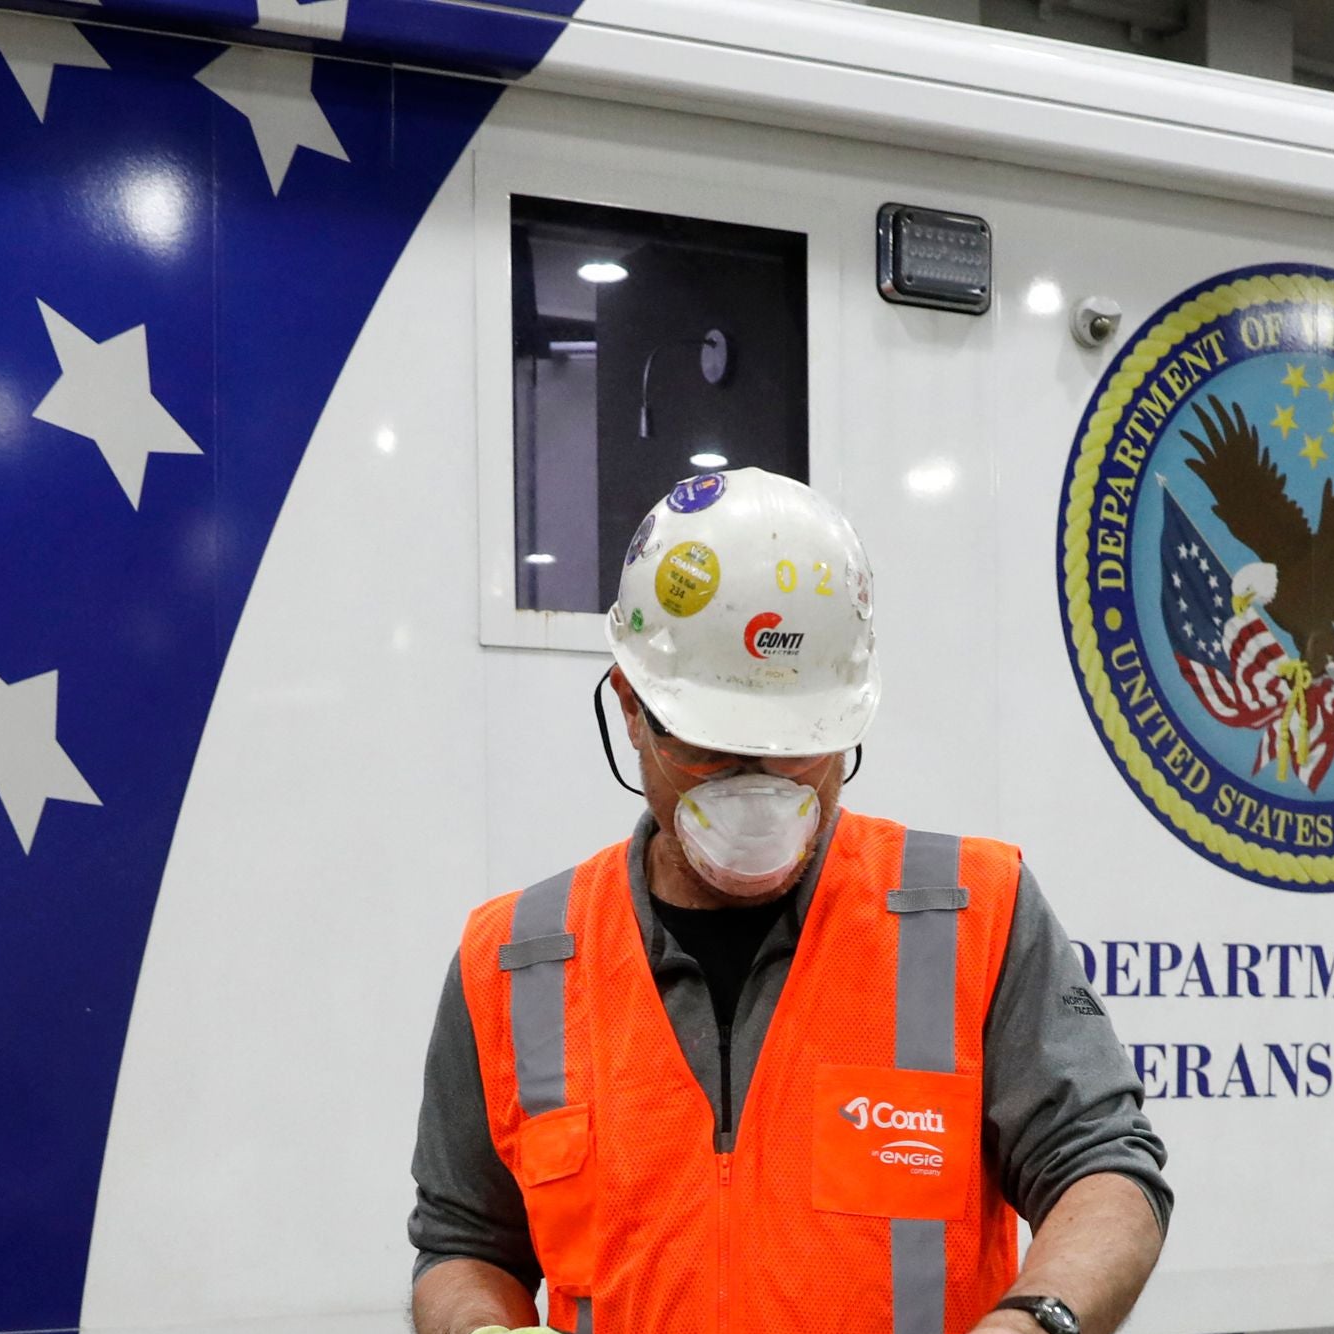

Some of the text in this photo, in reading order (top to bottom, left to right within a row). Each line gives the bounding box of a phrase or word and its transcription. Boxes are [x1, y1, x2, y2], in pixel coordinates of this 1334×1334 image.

[1098, 329, 1227, 592] DEPARTMENT
[1241, 313, 1285, 350] OF
[669, 584, 685, 599] 234
[757, 631, 805, 649] CONTI
[1111, 639, 1211, 794] UNITED
[1213, 786, 1334, 848] STATES
[1122, 1043, 1332, 1099] ERANS
[872, 1102, 945, 1133] Conti
[910, 1168, 941, 1176] company
